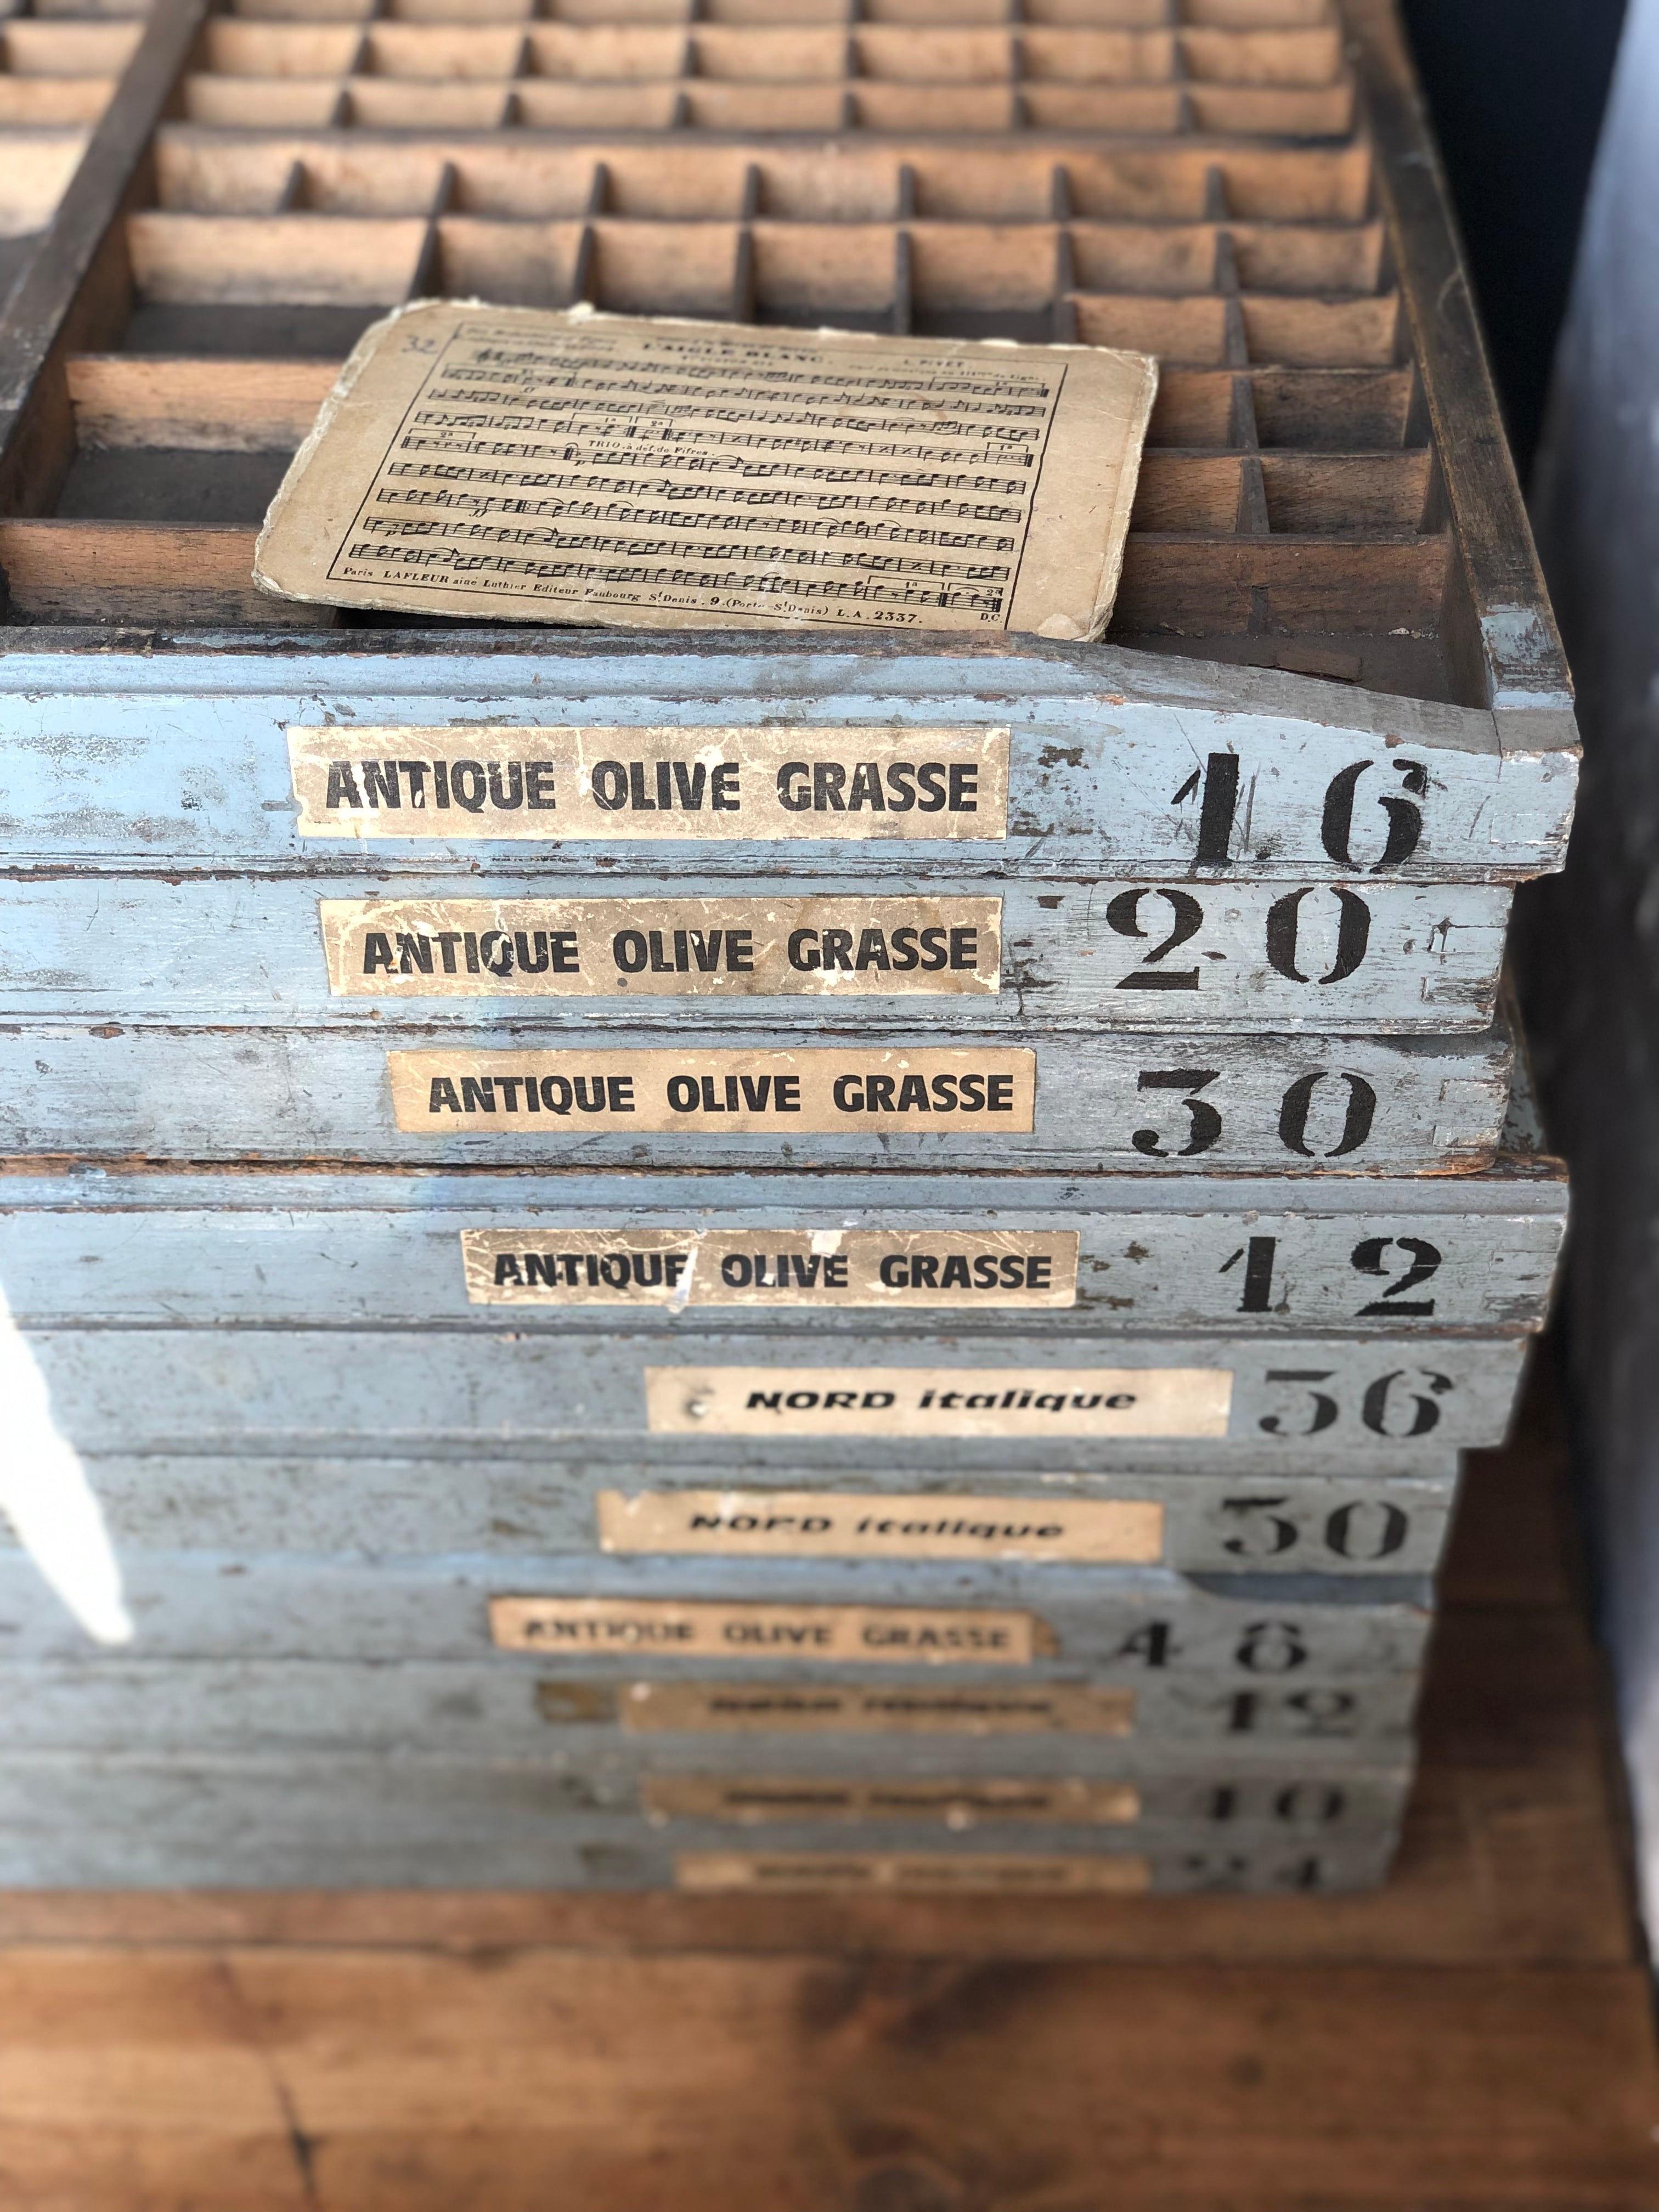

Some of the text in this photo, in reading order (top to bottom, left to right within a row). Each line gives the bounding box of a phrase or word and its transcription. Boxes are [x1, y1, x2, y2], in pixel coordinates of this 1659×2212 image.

[343, 567, 374, 577] Paris
[383, 570, 449, 584] LAFLEUR
[533, 584, 579, 595] Editeur
[584, 588, 641, 602] Faubourg
[326, 760, 978, 813] ANTIQUE OLIVE GRASSE
[364, 927, 977, 977] ANTIQUE OLIVE GRASSE
[430, 1074, 1013, 1115] ANTIQUE OLIVE GRASSE
[721, 1254, 848, 1288] OLIVE
[879, 1254, 1052, 1289] GRASSE
[746, 1390, 1137, 1414] NORD italique
[856, 1517, 1064, 1541] italique
